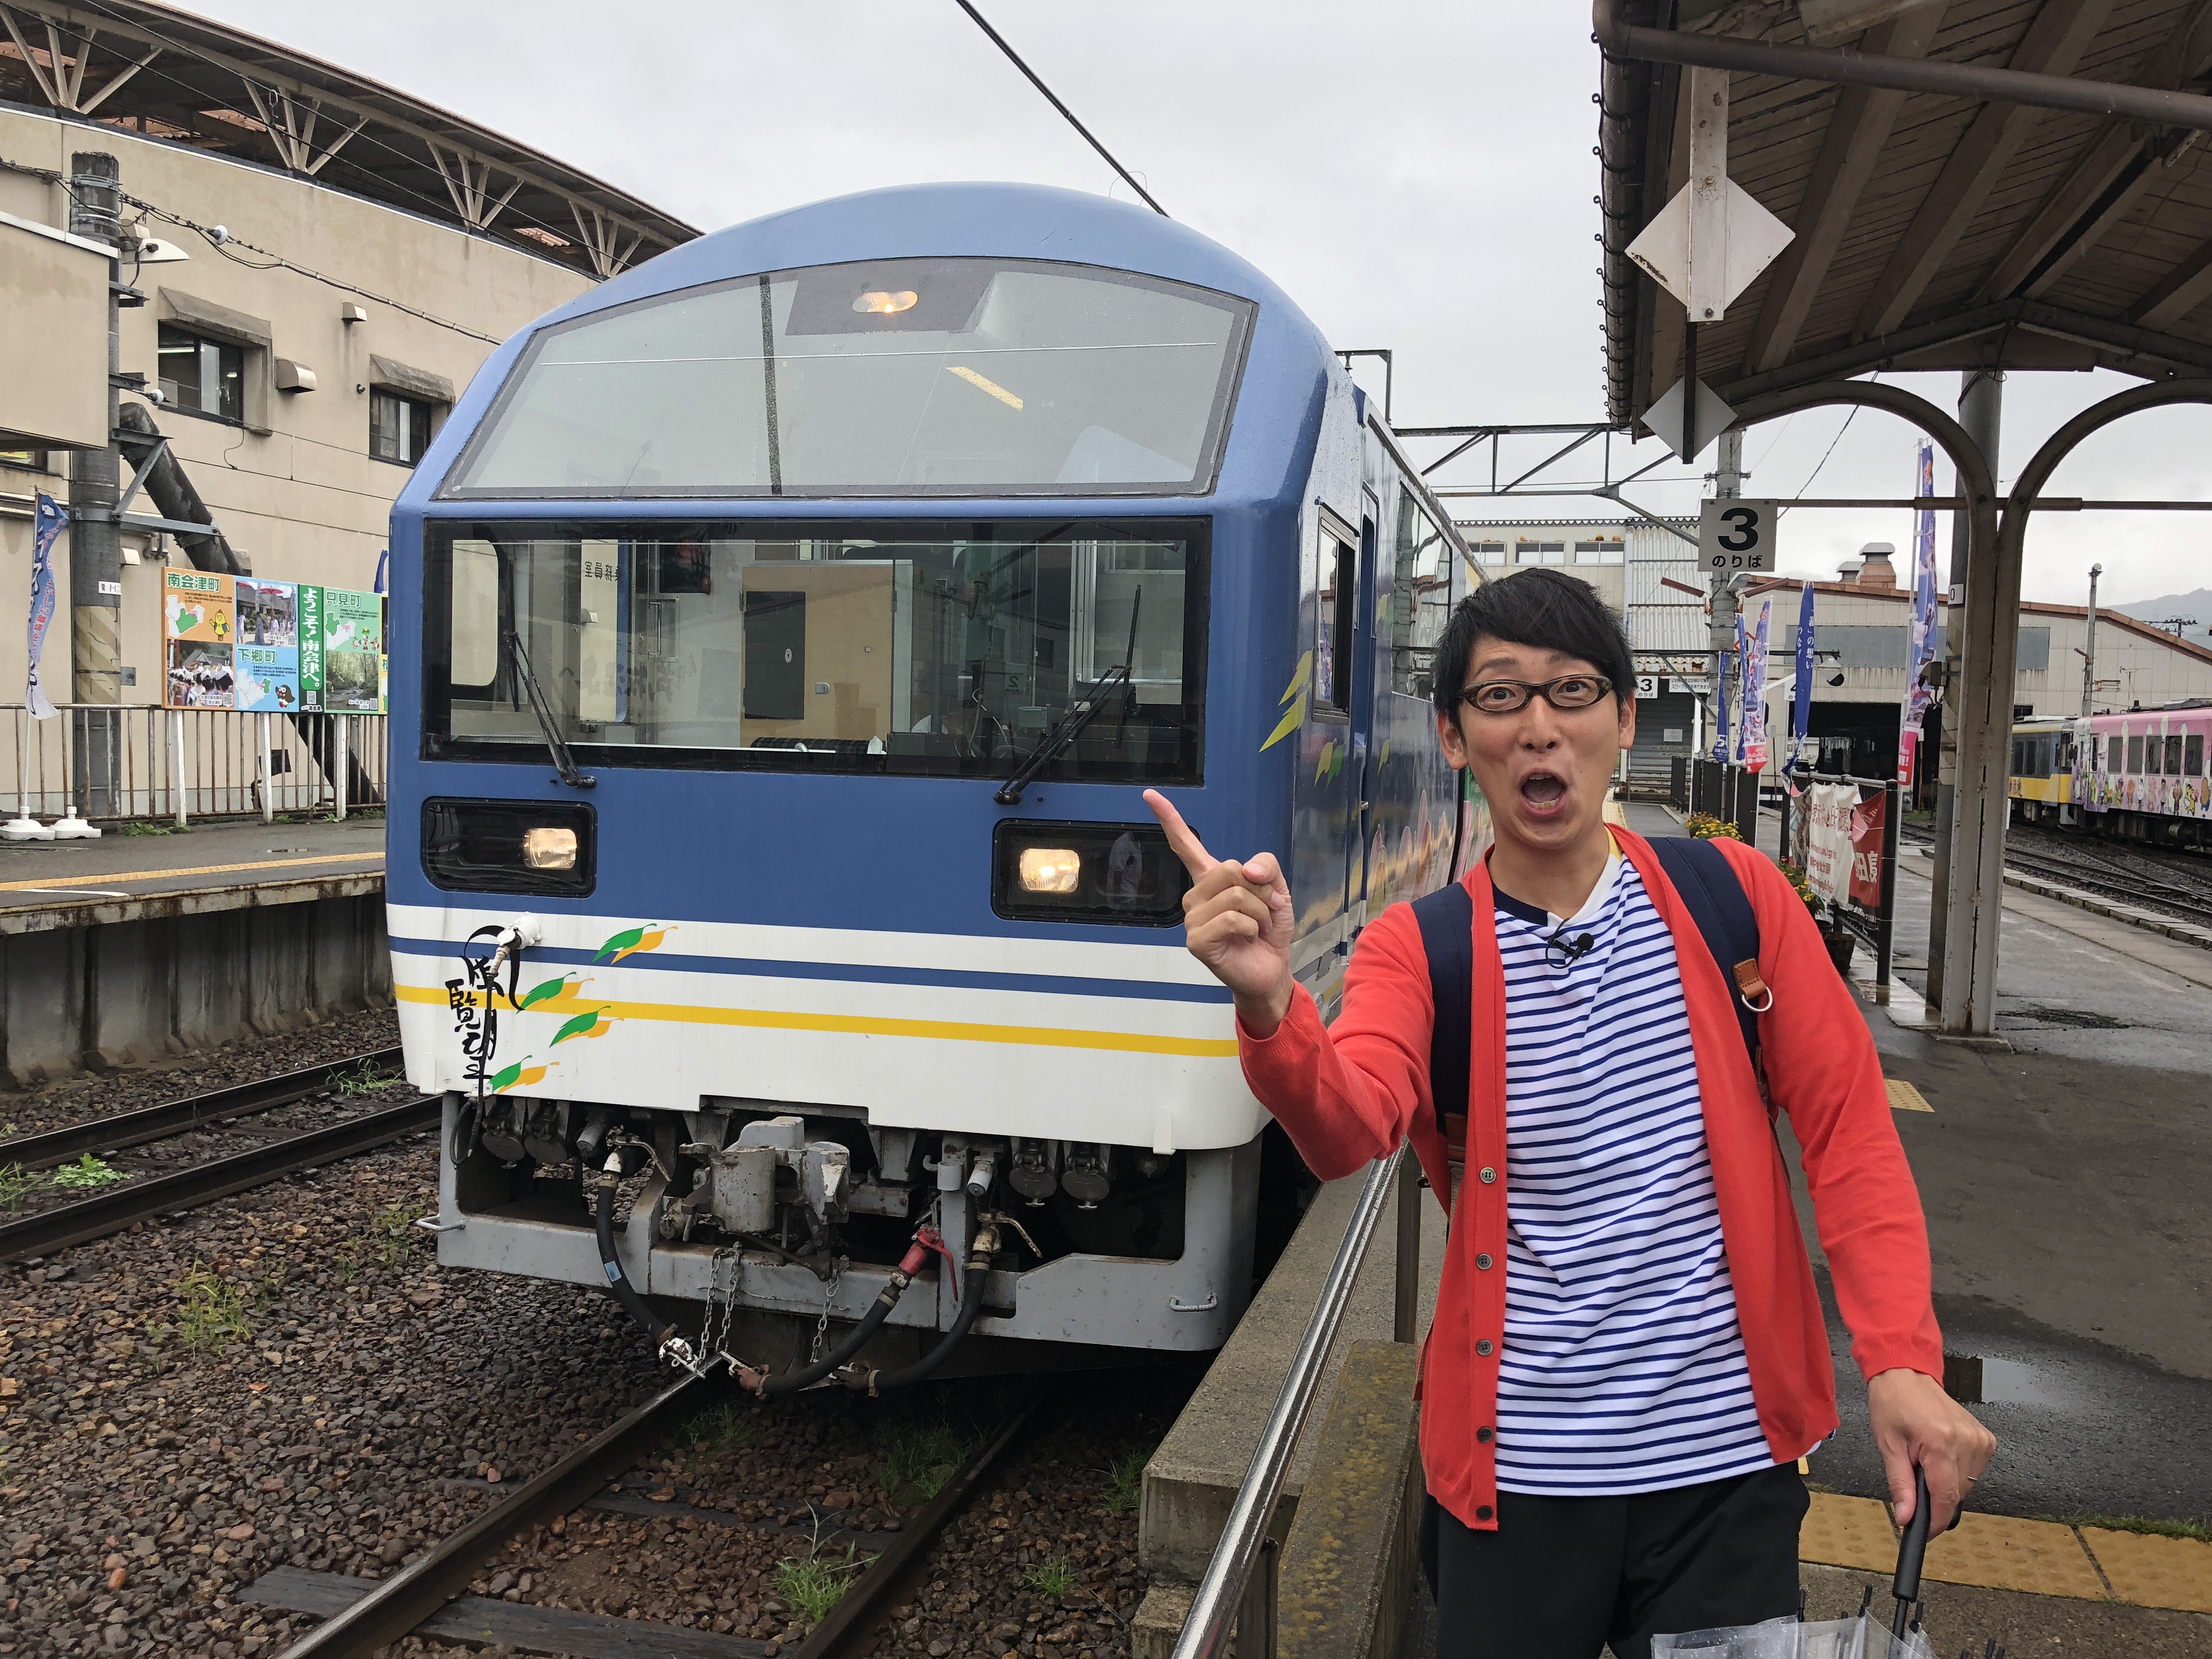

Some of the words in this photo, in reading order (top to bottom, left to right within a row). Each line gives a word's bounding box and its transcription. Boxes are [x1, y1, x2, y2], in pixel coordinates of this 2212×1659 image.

[1718, 507, 1758, 551] 3
[1712, 554, 1763, 568] のりば
[167, 572, 221, 592] 南会津町
[326, 591, 361, 608] 只見町
[302, 588, 320, 687] ようこそ！南会津へ。
[237, 647, 276, 664] 下郷町
[1640, 678, 1652, 692] 3
